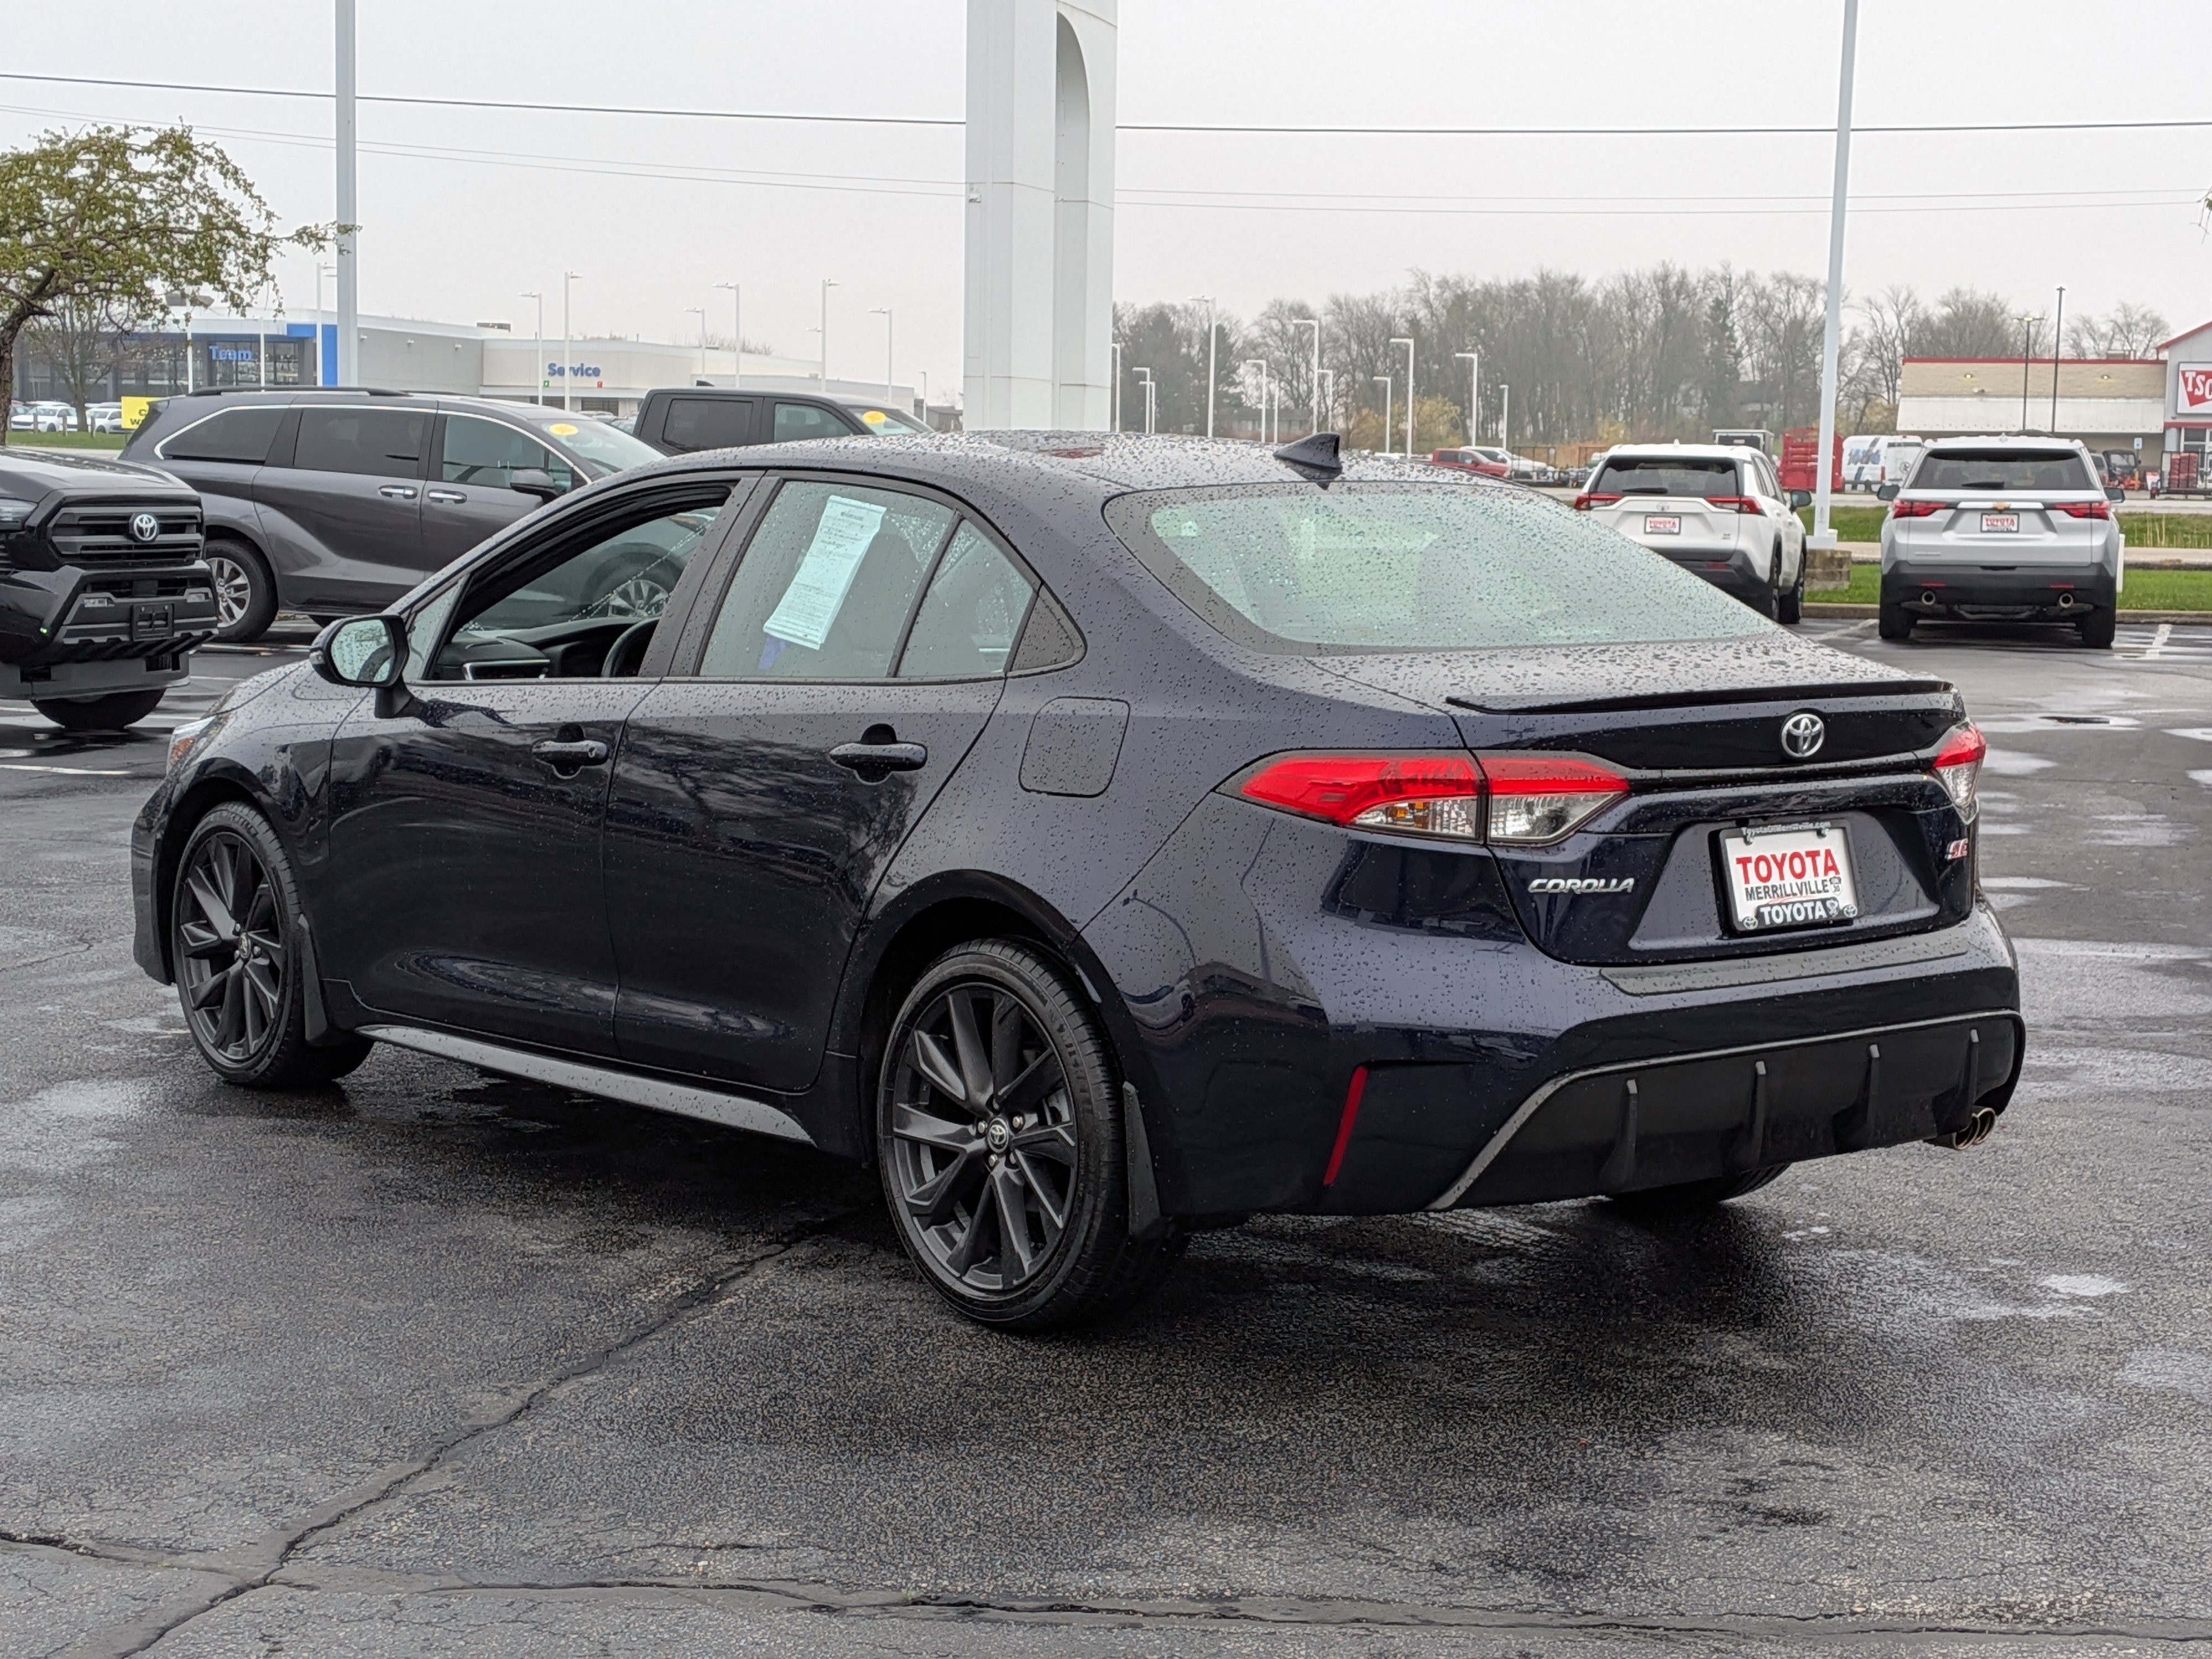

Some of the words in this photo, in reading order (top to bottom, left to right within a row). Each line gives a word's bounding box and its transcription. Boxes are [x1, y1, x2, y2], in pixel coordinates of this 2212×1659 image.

[208, 346, 253, 361] Team
[2185, 371, 2212, 399] TSC
[1735, 848, 1840, 885] TOYOTA
[1527, 877, 1635, 894] COROLLA
[1745, 879, 1829, 901] MERRILLVILLE
[1760, 901, 1828, 926] TOYOTA
